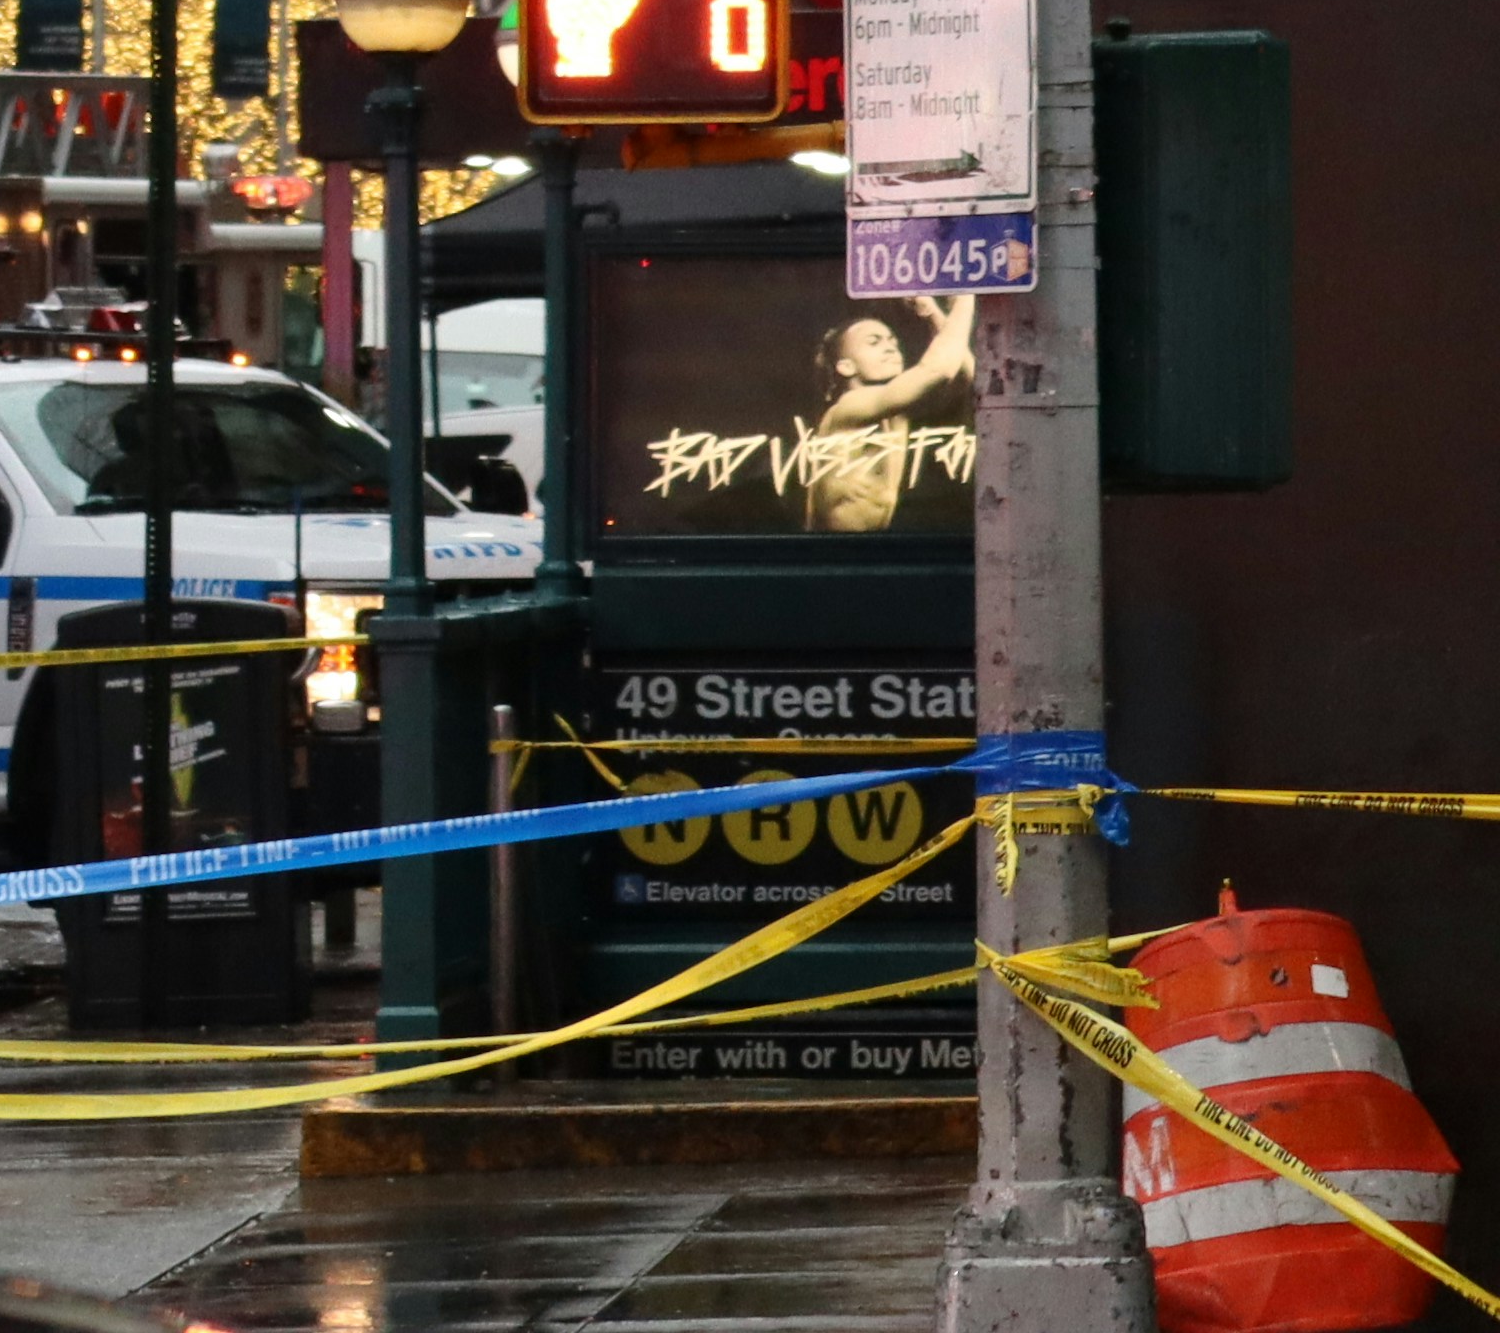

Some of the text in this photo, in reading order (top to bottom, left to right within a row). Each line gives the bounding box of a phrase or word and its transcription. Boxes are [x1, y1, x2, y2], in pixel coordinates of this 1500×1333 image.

[855, 16, 892, 44] 6pm
[909, 9, 980, 40] Midnight
[856, 61, 933, 88] Saturday
[855, 96, 893, 121] 8am
[910, 92, 980, 121] Midnight
[855, 239, 988, 286] 106045
[643, 427, 768, 498] BAD
[616, 675, 679, 719] 49
[695, 674, 853, 720] Street
[646, 882, 745, 902] Elevator
[879, 882, 953, 902] Street
[1049, 1000, 1071, 1024] DO
[1067, 1010, 1098, 1041] NOT
[1092, 1026, 1137, 1069] CROSS
[611, 1040, 702, 1069] Enter
[716, 1039, 787, 1069] with
[801, 1044, 837, 1069] or
[850, 1039, 911, 1075] buy
